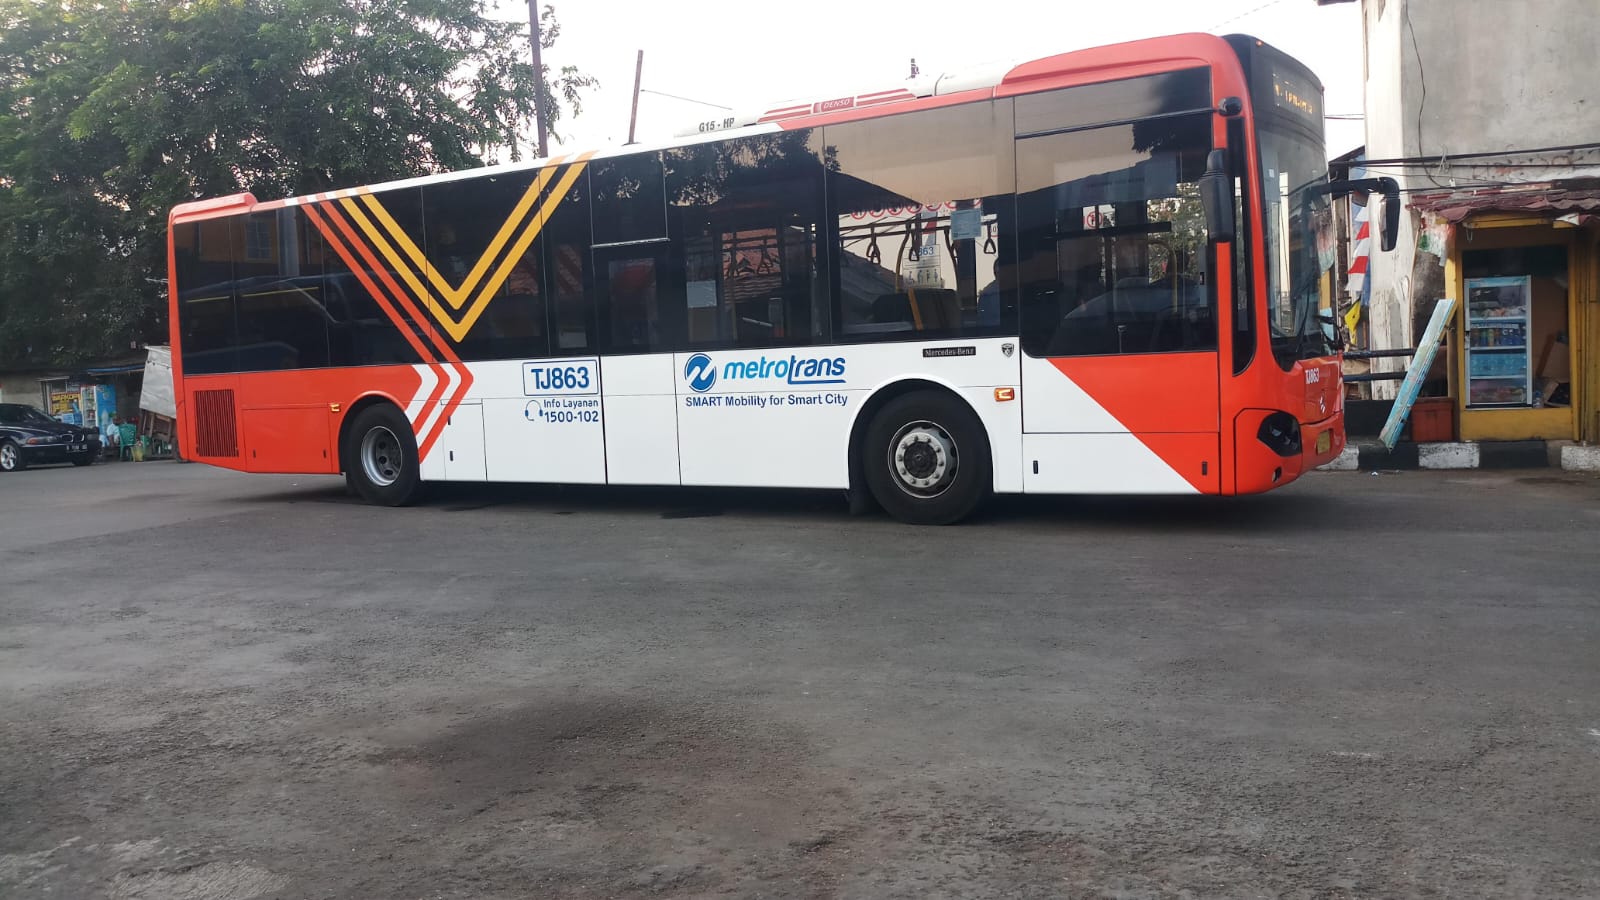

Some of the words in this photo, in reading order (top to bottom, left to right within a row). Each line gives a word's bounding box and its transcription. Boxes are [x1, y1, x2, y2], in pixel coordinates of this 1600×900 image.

[822, 98, 850, 110] DENSO
[698, 120, 716, 133] G15
[723, 117, 735, 129] HP
[723, 355, 846, 385] metrotrans
[531, 367, 589, 389] TJ863
[543, 398, 561, 408] Info
[563, 398, 598, 409] Layanan
[686, 396, 722, 407] SMART
[725, 394, 767, 408] Mobility
[769, 395, 784, 406] for
[787, 394, 822, 406] Smart
[825, 393, 848, 407] City
[544, 411, 599, 422] 1500-102
